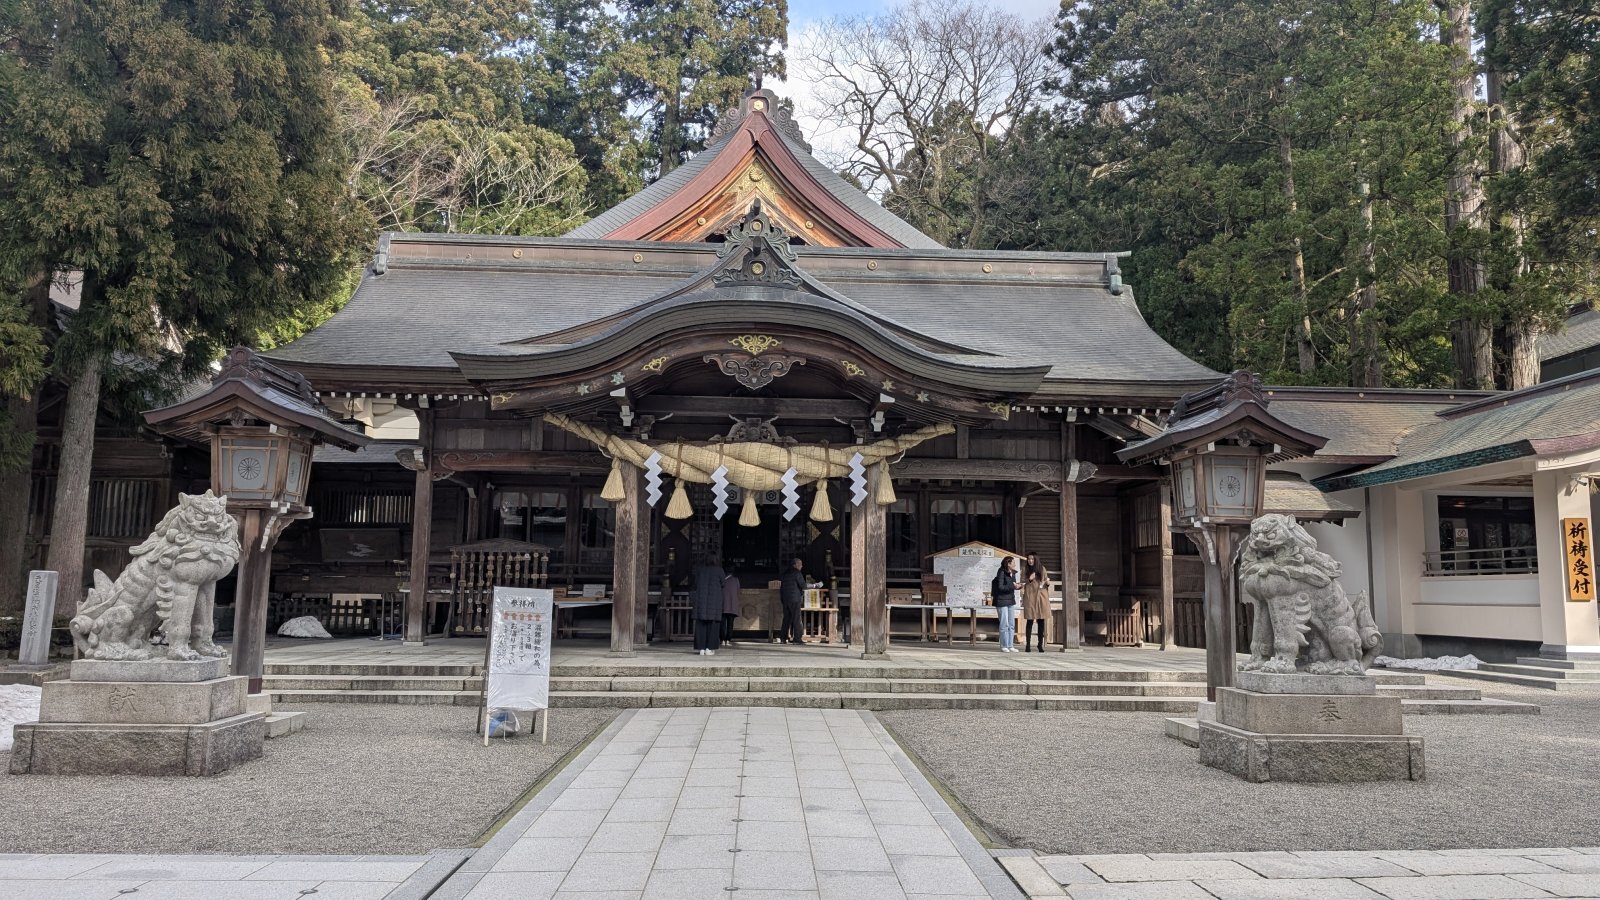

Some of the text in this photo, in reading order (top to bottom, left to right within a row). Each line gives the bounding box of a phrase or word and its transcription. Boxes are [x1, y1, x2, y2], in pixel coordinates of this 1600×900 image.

[1568, 522, 1591, 594] 祈祷受付
[1318, 700, 1342, 724] 奉
